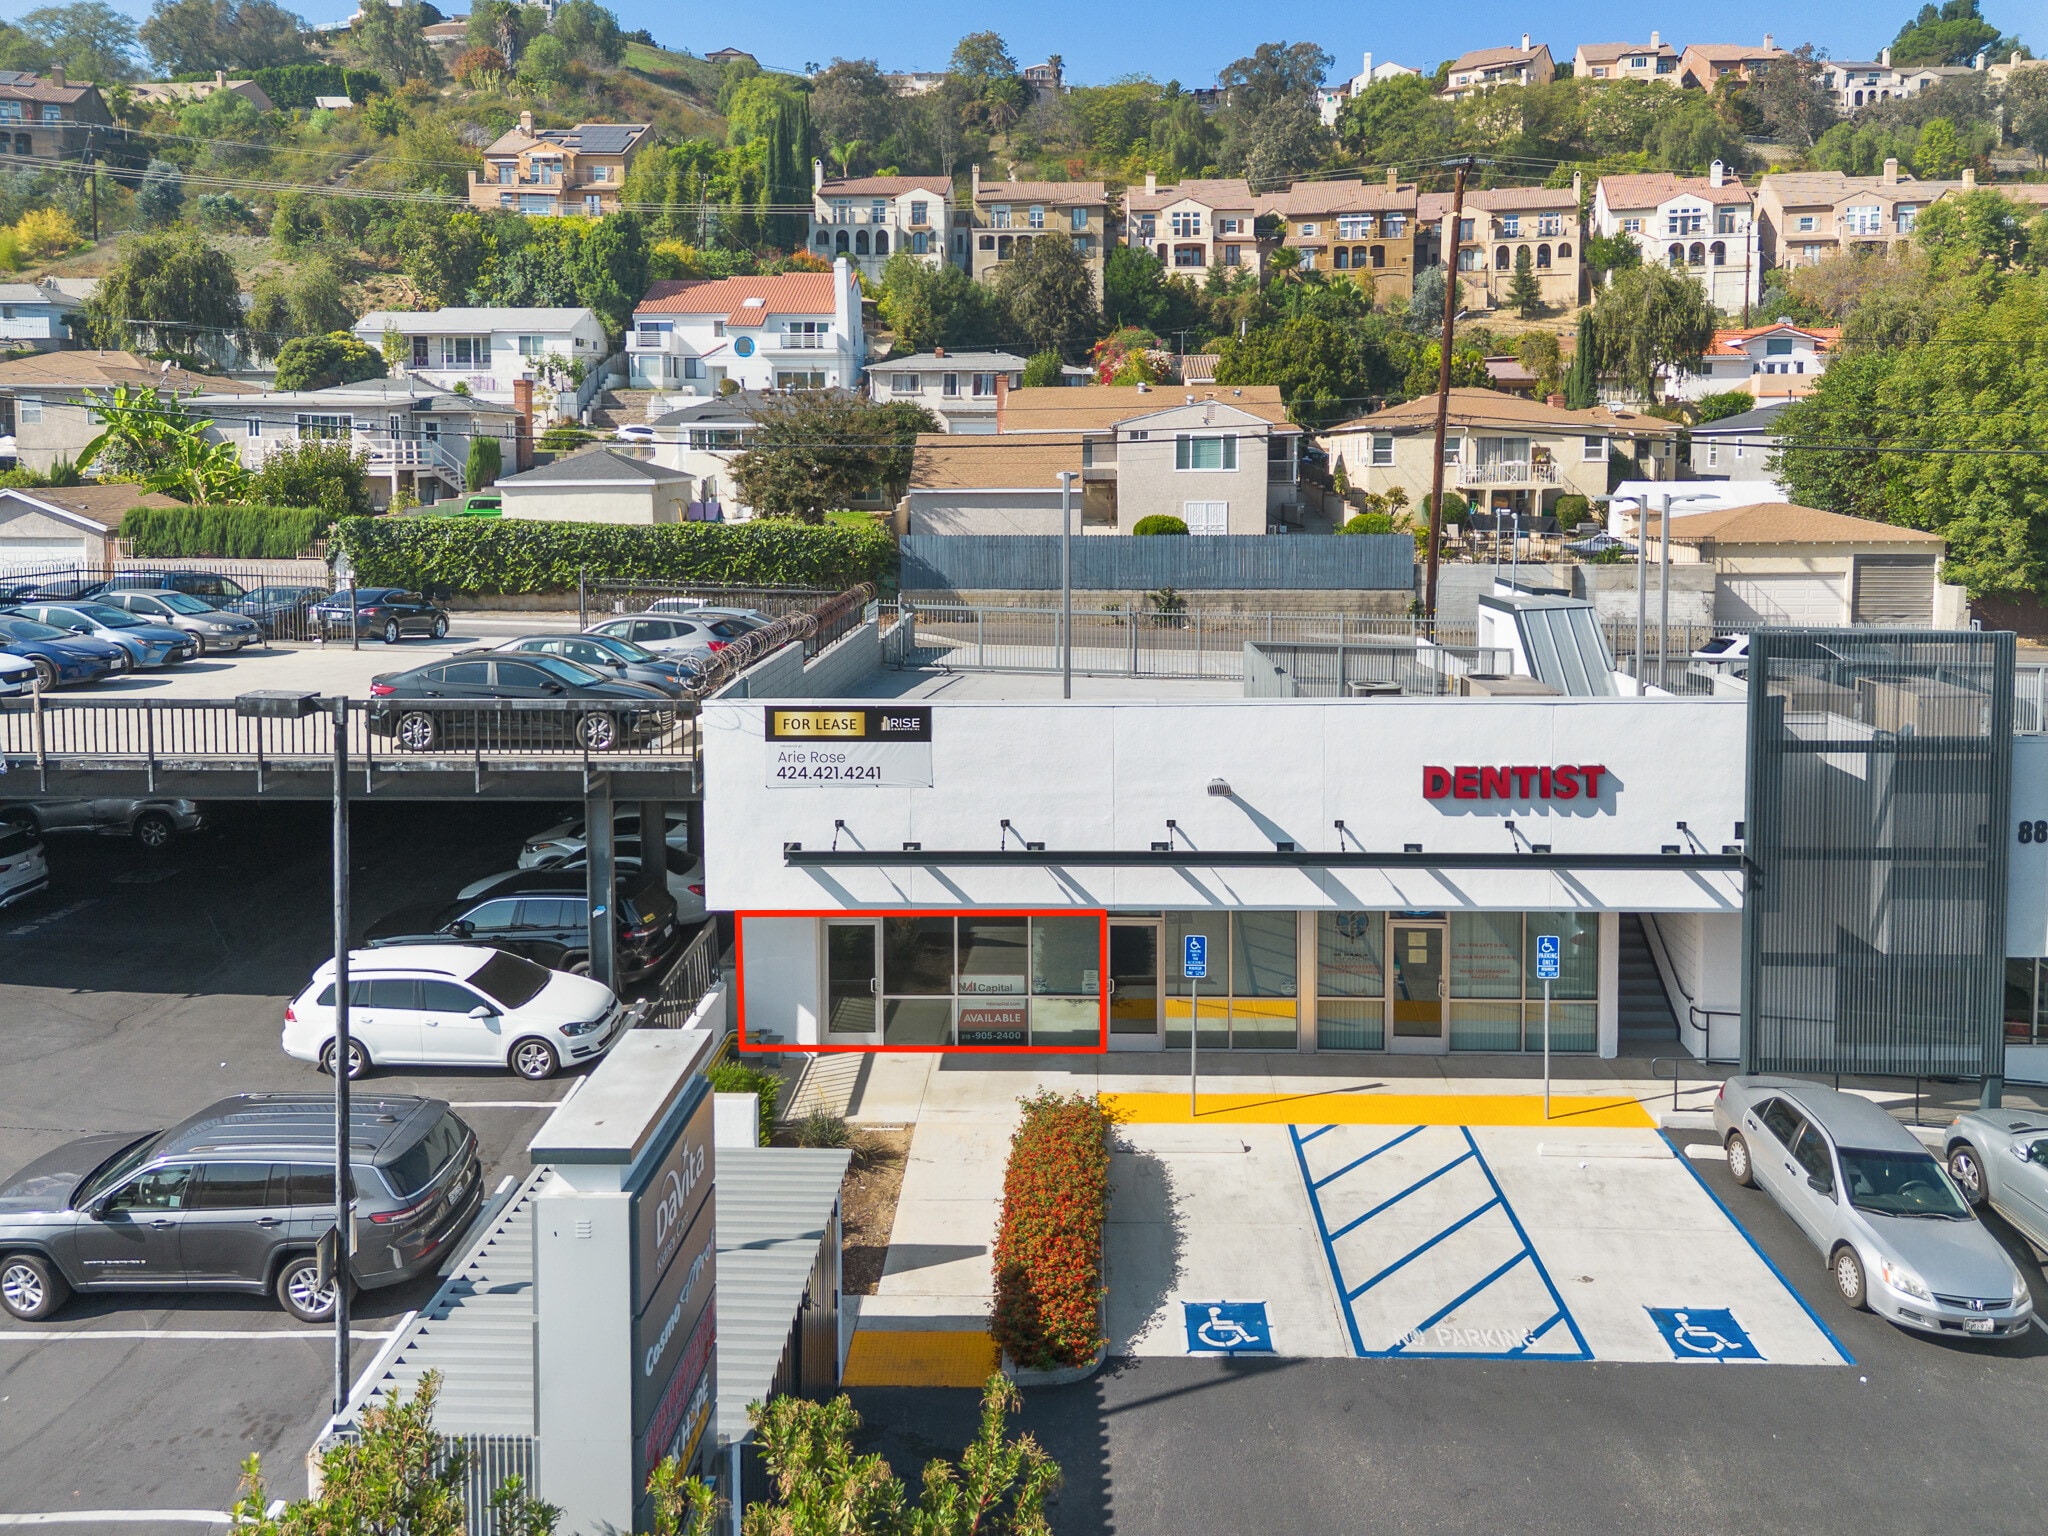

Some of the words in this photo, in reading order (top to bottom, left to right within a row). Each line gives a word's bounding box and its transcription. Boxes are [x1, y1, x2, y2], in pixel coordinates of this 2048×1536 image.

[783, 718, 811, 730] FOR
[815, 718, 858, 730] LEASE
[891, 717, 921, 728] RISE
[777, 750, 806, 763] Arie
[810, 751, 846, 763] Rose
[776, 766, 881, 780] 424.421.4241
[1422, 764, 1606, 800] DENTIST
[978, 983, 1013, 994] Capital
[963, 1013, 1021, 1023] AVAILABLE
[656, 1144, 704, 1250] DaVita
